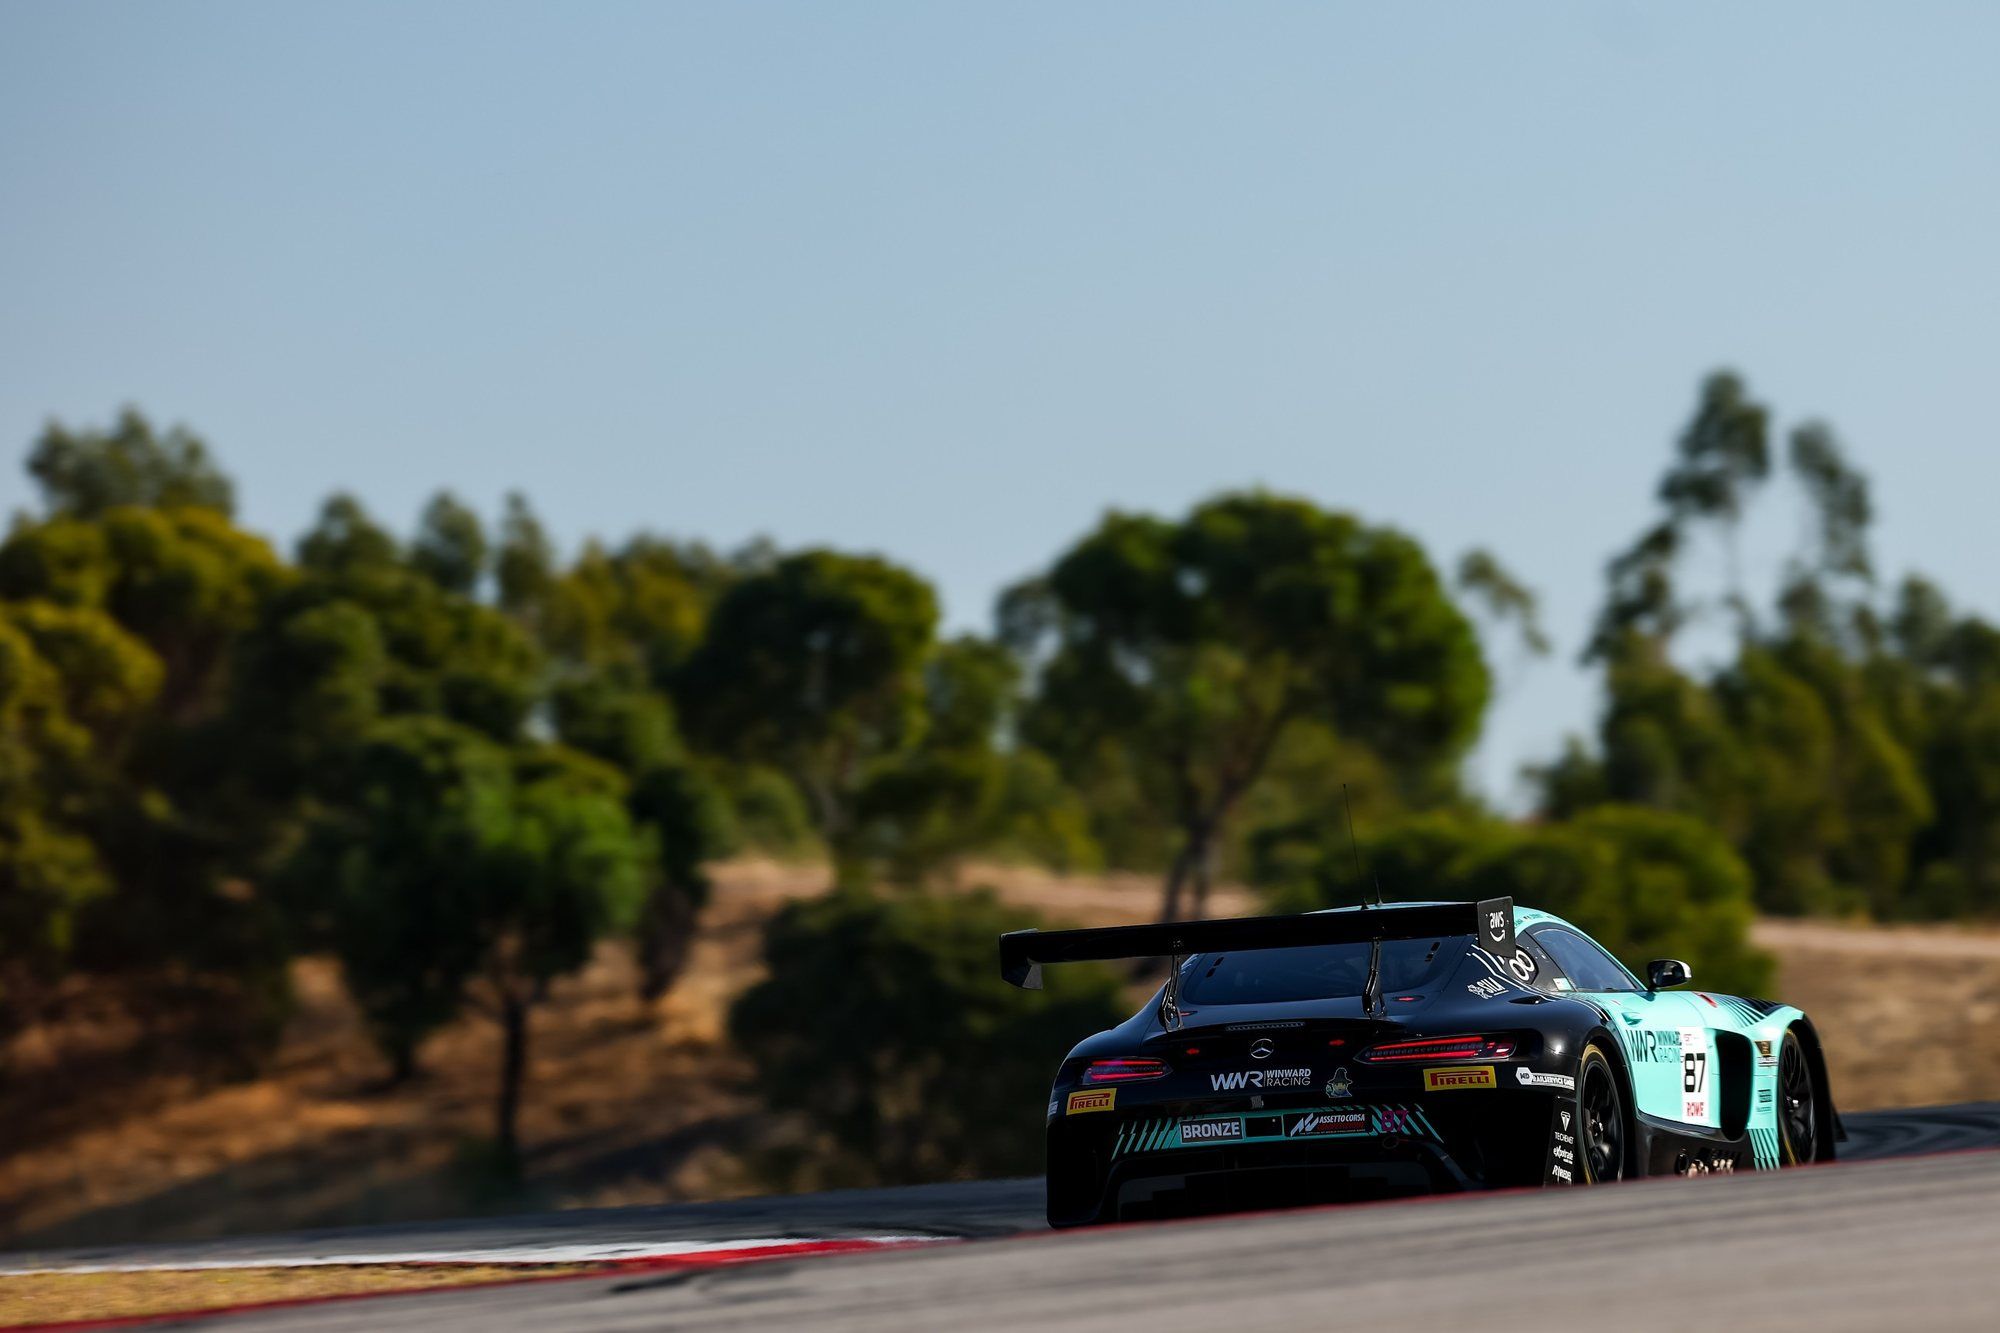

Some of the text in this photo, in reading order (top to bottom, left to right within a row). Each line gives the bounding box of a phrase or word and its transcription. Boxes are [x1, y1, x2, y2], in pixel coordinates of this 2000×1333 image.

[1490, 911, 1504, 929] aws
[1266, 1068, 1311, 1078] WINWARD
[1266, 1077, 1311, 1087] RACING
[1430, 1070, 1489, 1087] PIRELLI
[1684, 1053, 1706, 1093] 87
[1069, 1092, 1111, 1110] PIRELLI
[1318, 1113, 1366, 1124] ASSETTO CORSA
[1381, 1109, 1408, 1132] 87
[1182, 1121, 1240, 1139] BRONZE
